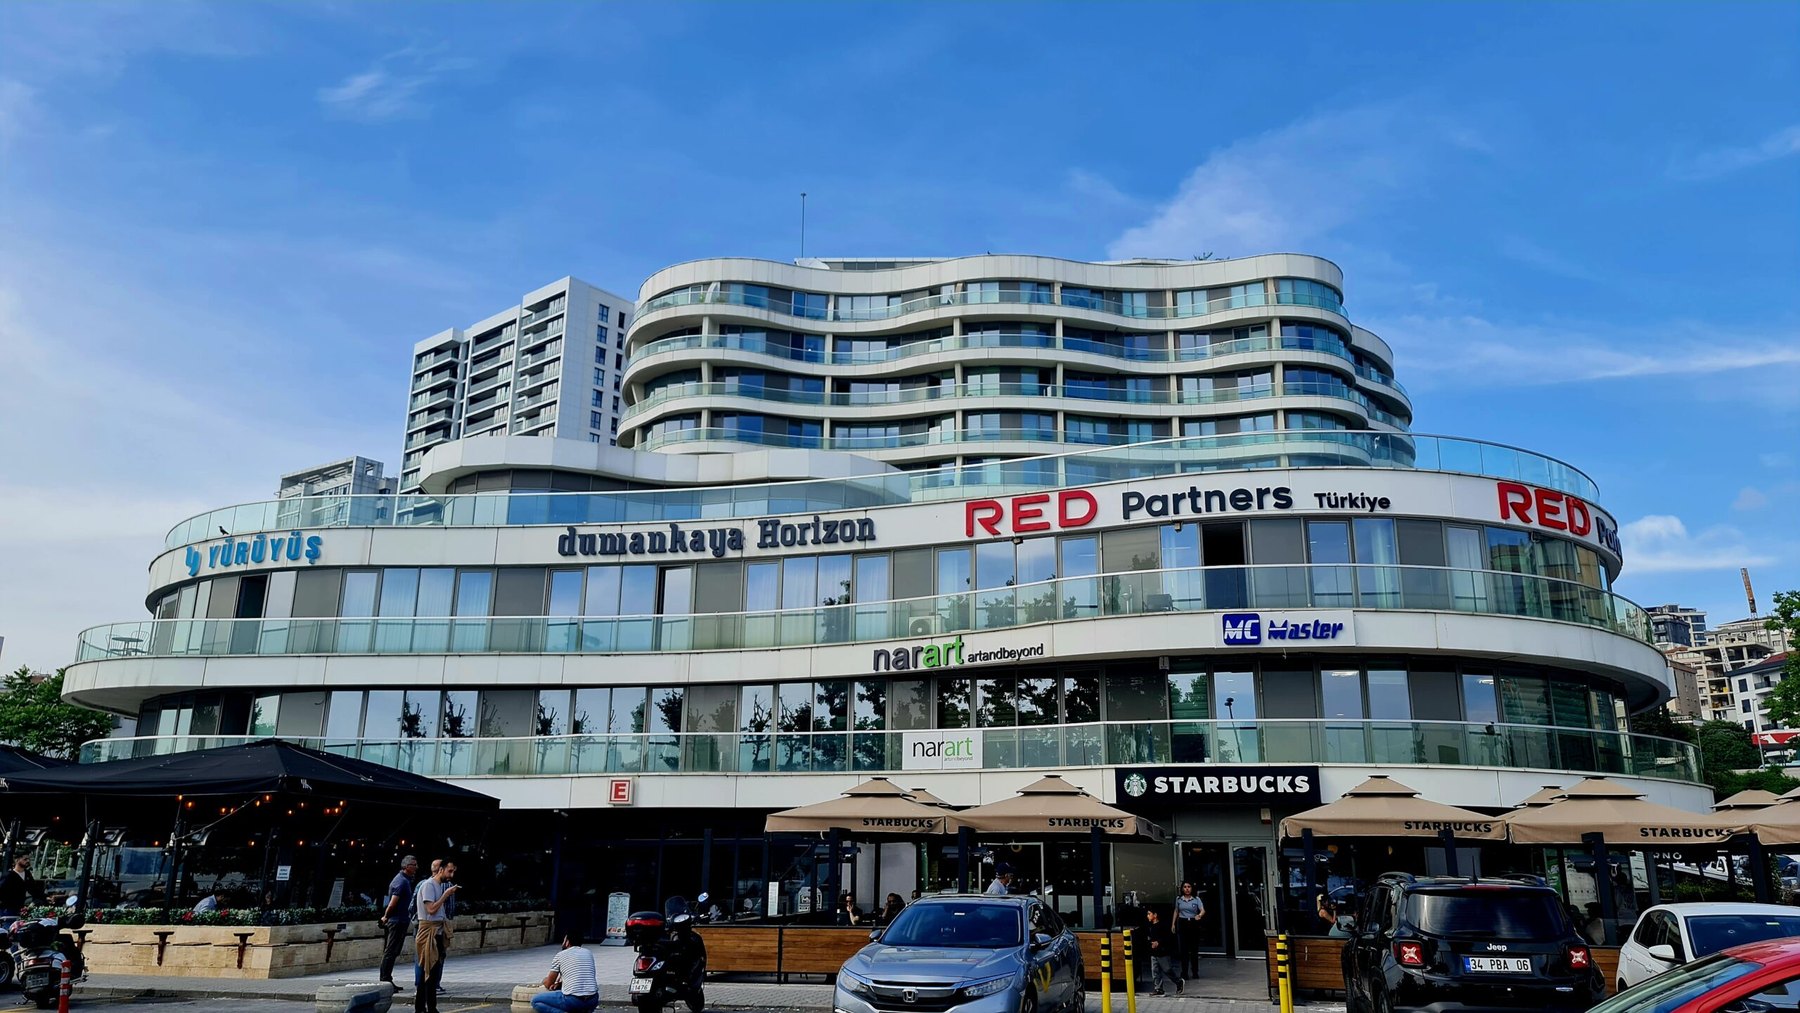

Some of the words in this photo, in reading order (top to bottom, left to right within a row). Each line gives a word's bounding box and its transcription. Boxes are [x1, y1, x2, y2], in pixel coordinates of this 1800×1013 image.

[965, 489, 1098, 538] RED
[1122, 486, 1294, 520] Partners
[1314, 492, 1391, 513] Türkiye
[1497, 482, 1591, 536] RED
[558, 523, 744, 558] dumankaya
[757, 515, 876, 548] Horizon
[208, 531, 322, 569] YÜRÜYÜŞ
[1224, 619, 1260, 640] MC
[1268, 619, 1344, 640] Master
[873, 634, 965, 672] narart
[967, 643, 1044, 663] artandbeyond
[912, 737, 973, 758] narart
[613, 783, 627, 799] E
[1154, 775, 1311, 794] STARBUCKS
[862, 817, 934, 828] STARBUCKS
[1048, 817, 1125, 828] STARBUCKS
[1404, 821, 1492, 833] STARBUCKS
[1640, 827, 1734, 838] STARBUCKS
[1486, 943, 1507, 952] Jeep
[1470, 958, 1484, 970] 34
[1489, 959, 1510, 971] PBA
[1516, 959, 1529, 971] 06
